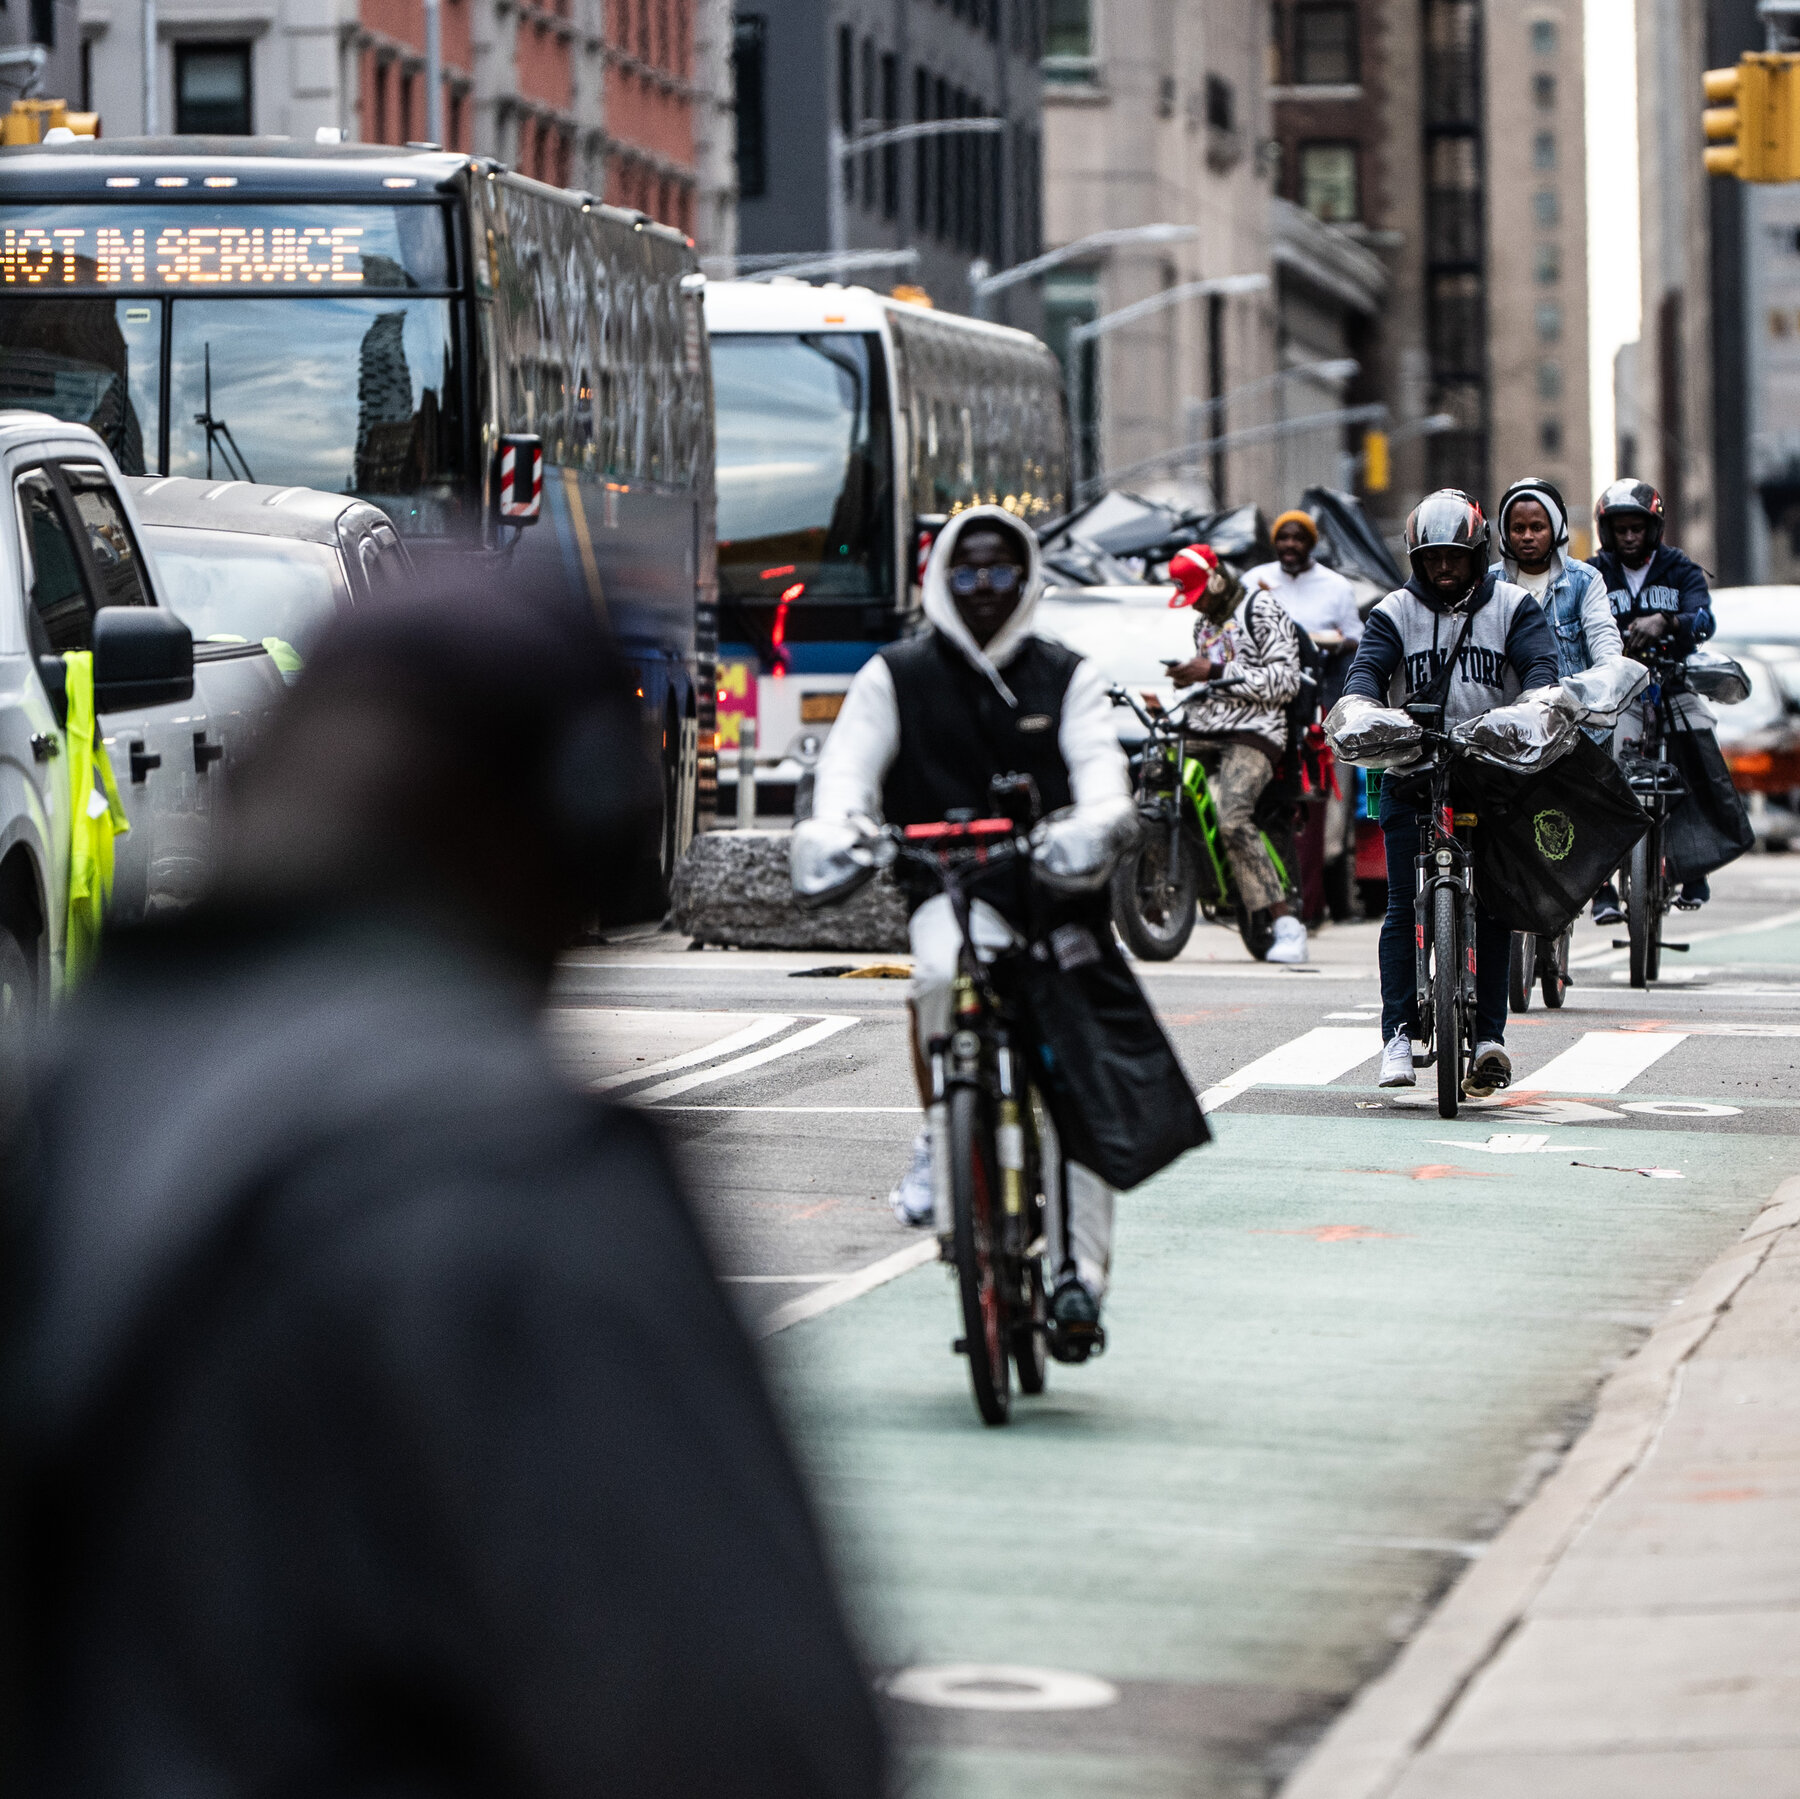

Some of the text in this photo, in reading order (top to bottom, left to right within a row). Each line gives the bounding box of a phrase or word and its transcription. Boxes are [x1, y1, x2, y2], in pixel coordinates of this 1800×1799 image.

[97, 229, 145, 282] IN
[157, 228, 364, 282] SERVICE
[1607, 585, 1680, 615] EW YORK
[1457, 646, 1506, 690] YORK
